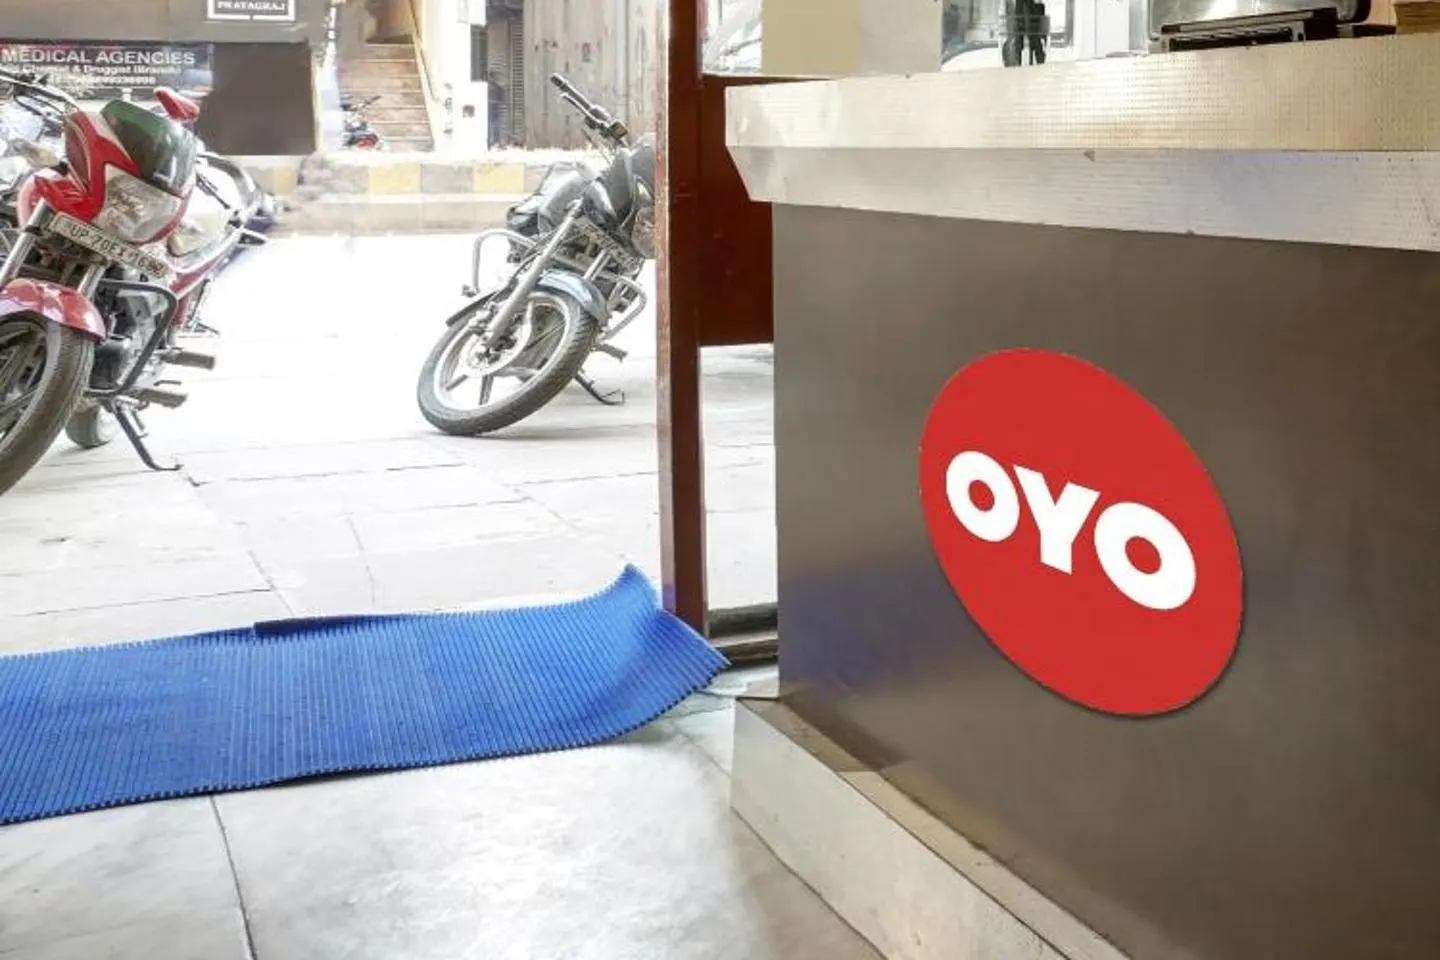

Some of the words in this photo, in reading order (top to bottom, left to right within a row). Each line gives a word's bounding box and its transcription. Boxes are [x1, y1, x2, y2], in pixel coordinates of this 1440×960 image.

[2, 48, 91, 64] MEDICAL
[95, 49, 196, 65] AGENCIES
[946, 450, 1197, 611] OYO
